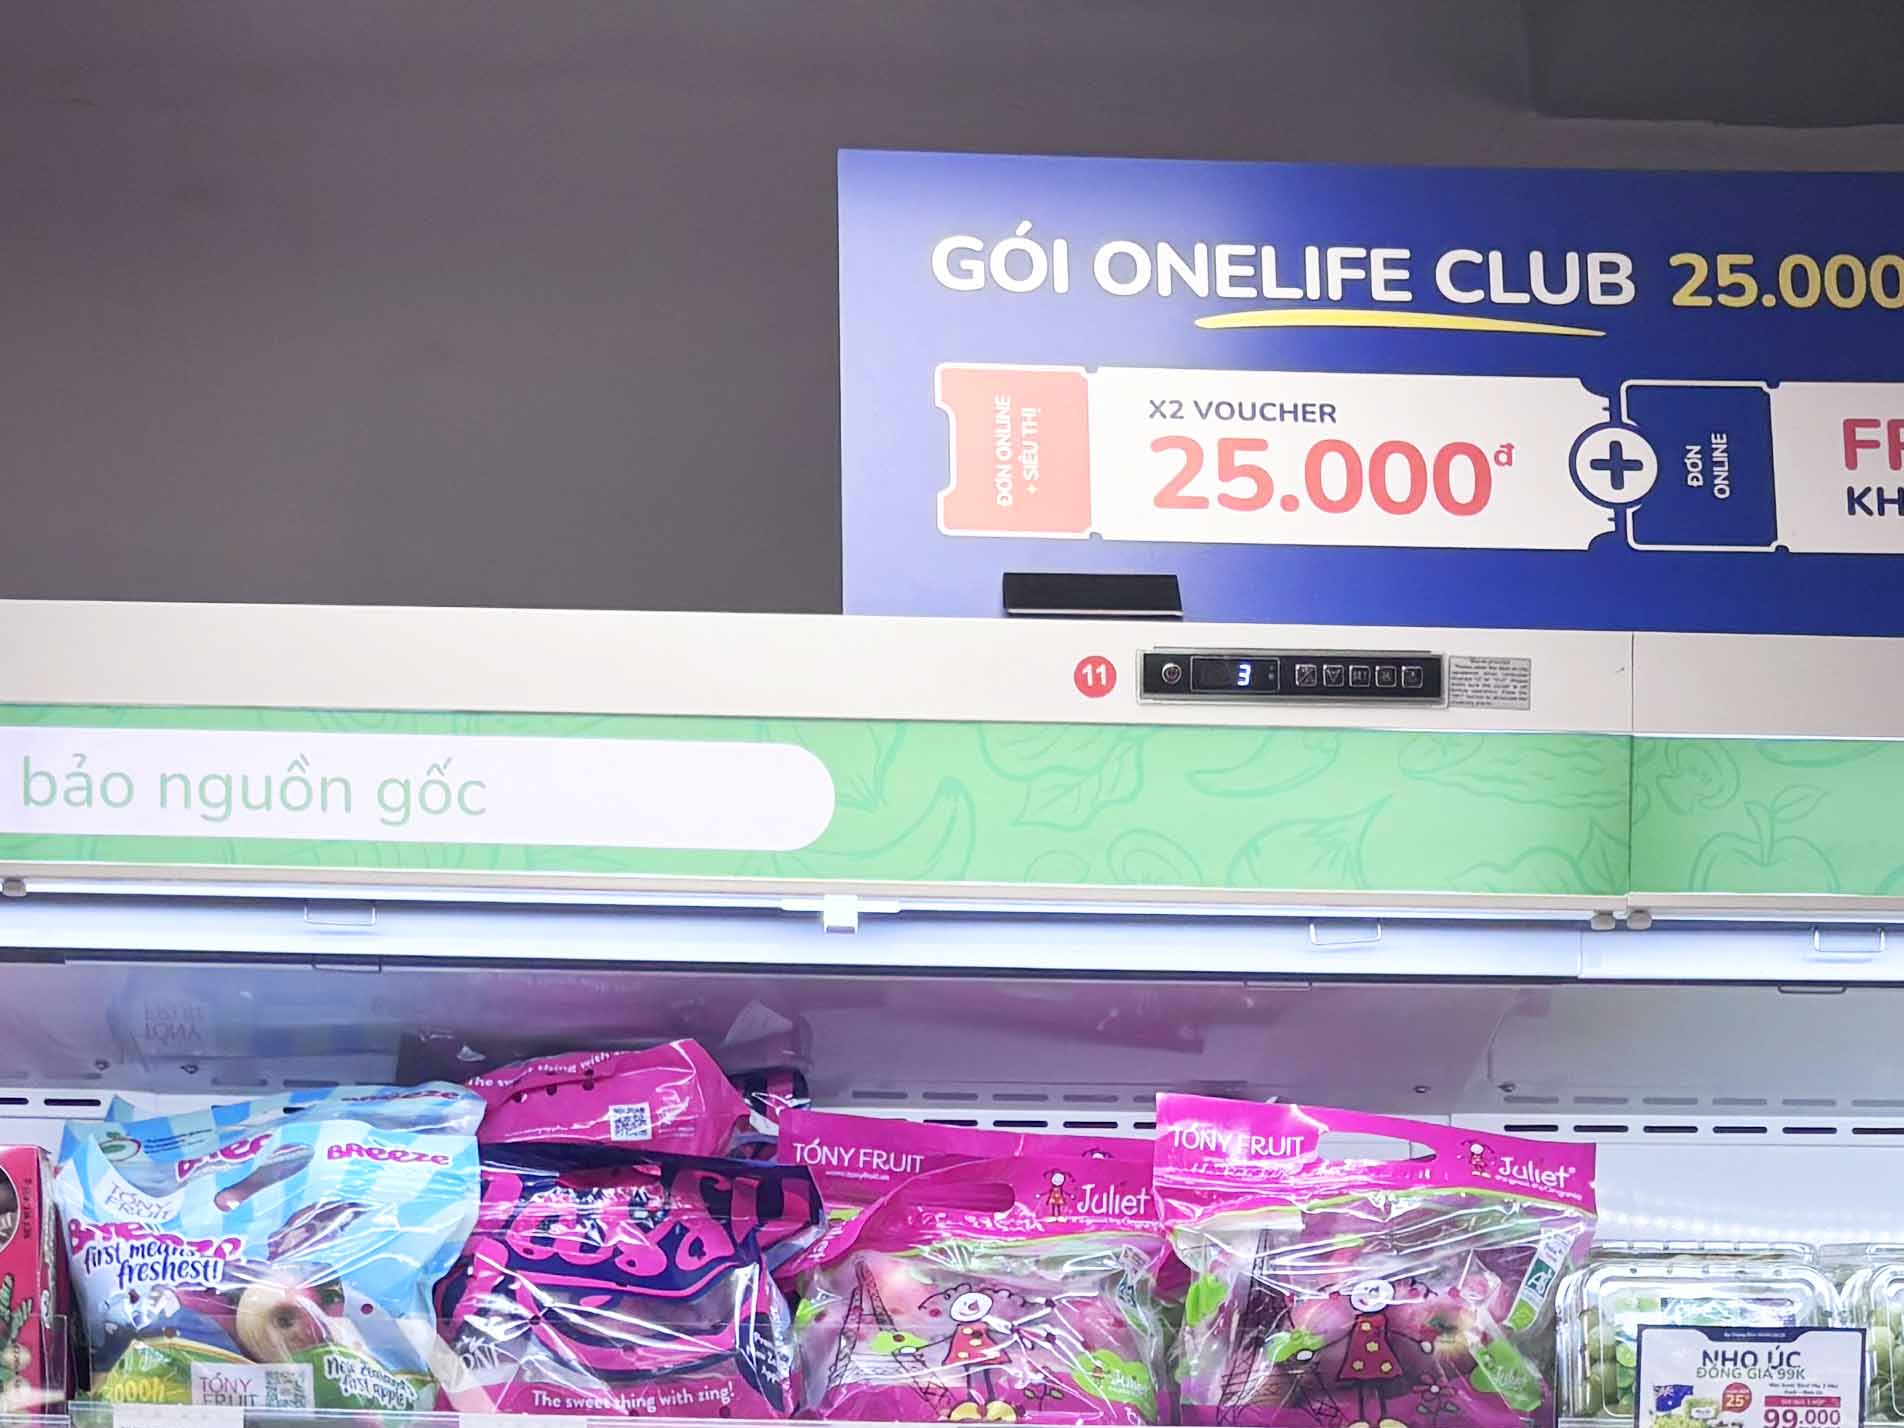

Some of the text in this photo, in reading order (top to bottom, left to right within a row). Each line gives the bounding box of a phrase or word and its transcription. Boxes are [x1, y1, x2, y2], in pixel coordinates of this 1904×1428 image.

[931, 220, 1069, 294] GÓI
[1094, 239, 1413, 302] ONELIFE
[1435, 249, 1635, 306] CLUB
[1148, 400, 1338, 425] X2 VOUCHER
[995, 395, 1013, 508] ĐƠN ONLINE
[1686, 432, 1730, 499] ĐƠN ONLINE
[1081, 665, 1108, 688] 11
[1237, 664, 1252, 686] 3
[21, 752, 135, 810] bảo
[158, 757, 354, 823] nguồn
[376, 758, 486, 825] gốc
[794, 1141, 925, 1174] TÓNY FRUIT
[1171, 1125, 1304, 1158] TÓNY FRUIT
[1499, 1155, 1570, 1187] Juliet
[1078, 1185, 1148, 1217] Juliet
[532, 1389, 561, 1408] The
[659, 1388, 694, 1406] with
[698, 1381, 734, 1404] zing!
